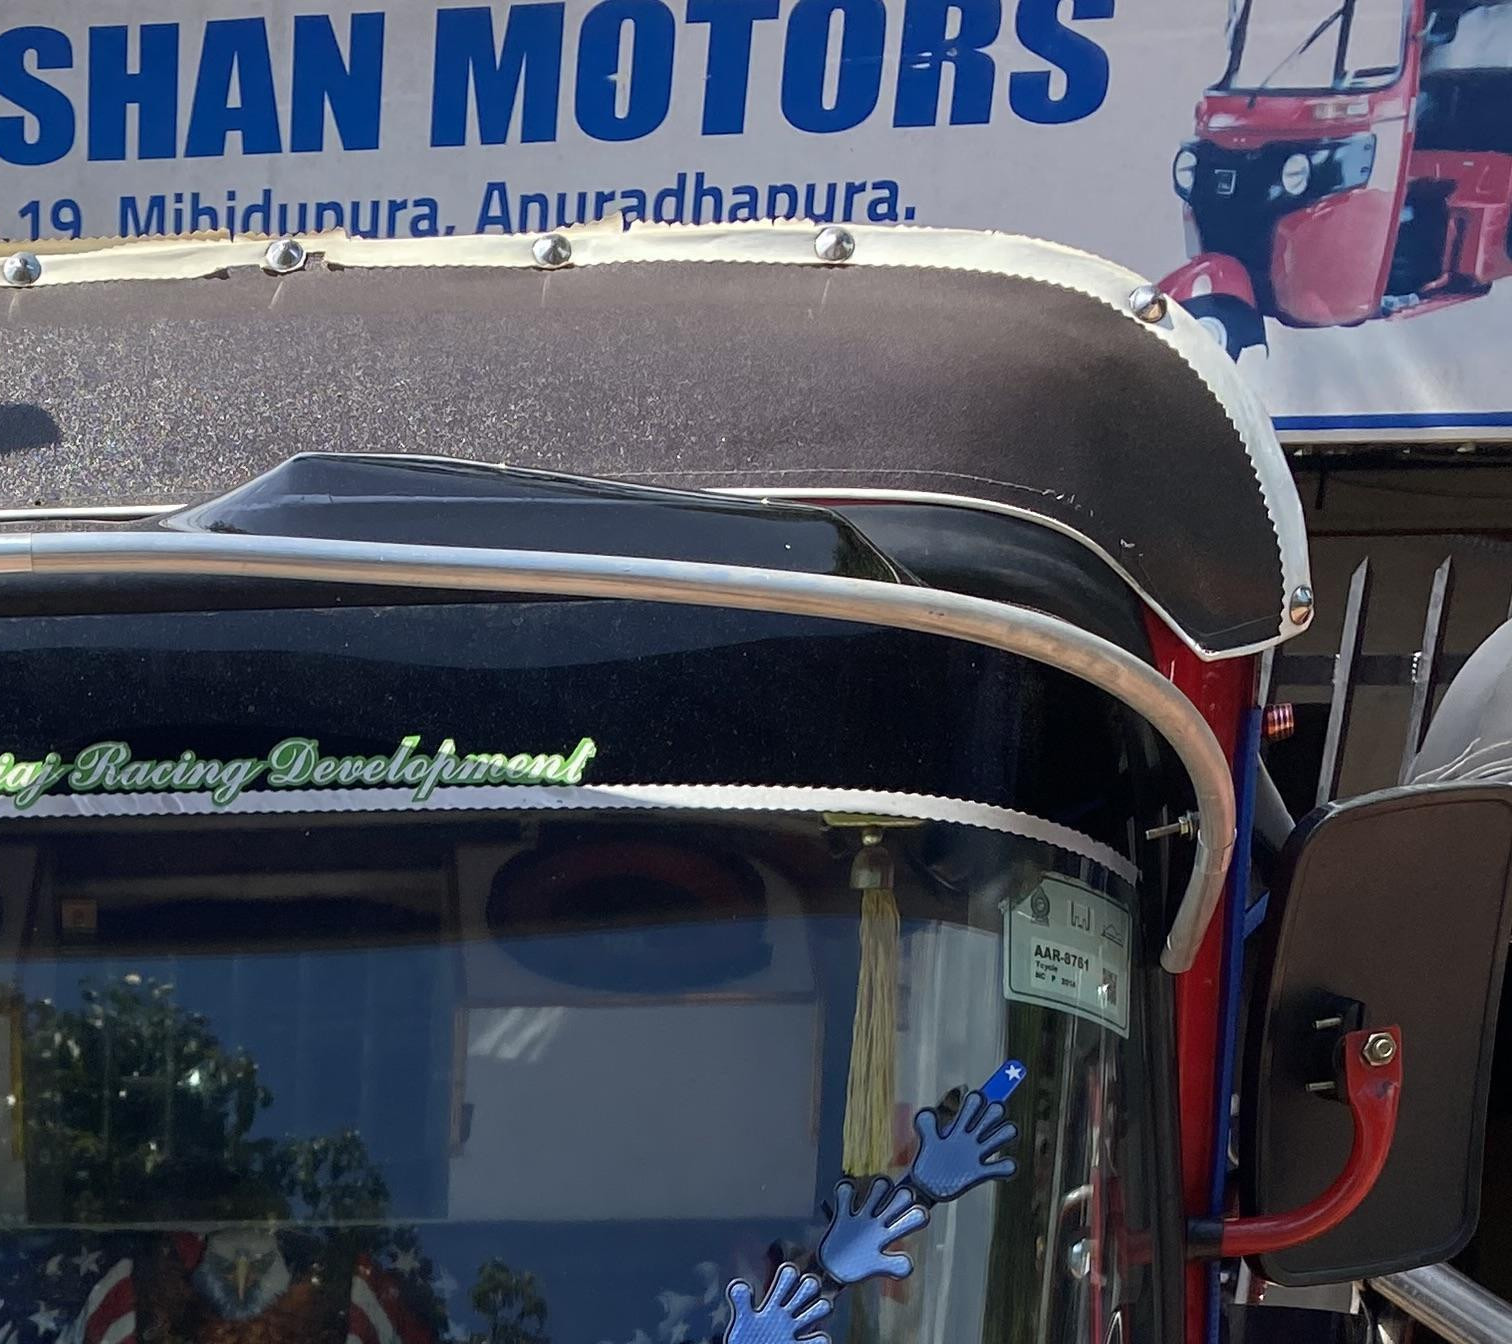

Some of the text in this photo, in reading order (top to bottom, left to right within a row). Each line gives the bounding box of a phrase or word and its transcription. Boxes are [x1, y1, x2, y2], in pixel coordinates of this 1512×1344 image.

[430, 0, 1115, 148] MOTORS
[476, 171, 916, 232] Anuradhapura.
[69, 741, 260, 806] Racing
[266, 735, 598, 802] Development
